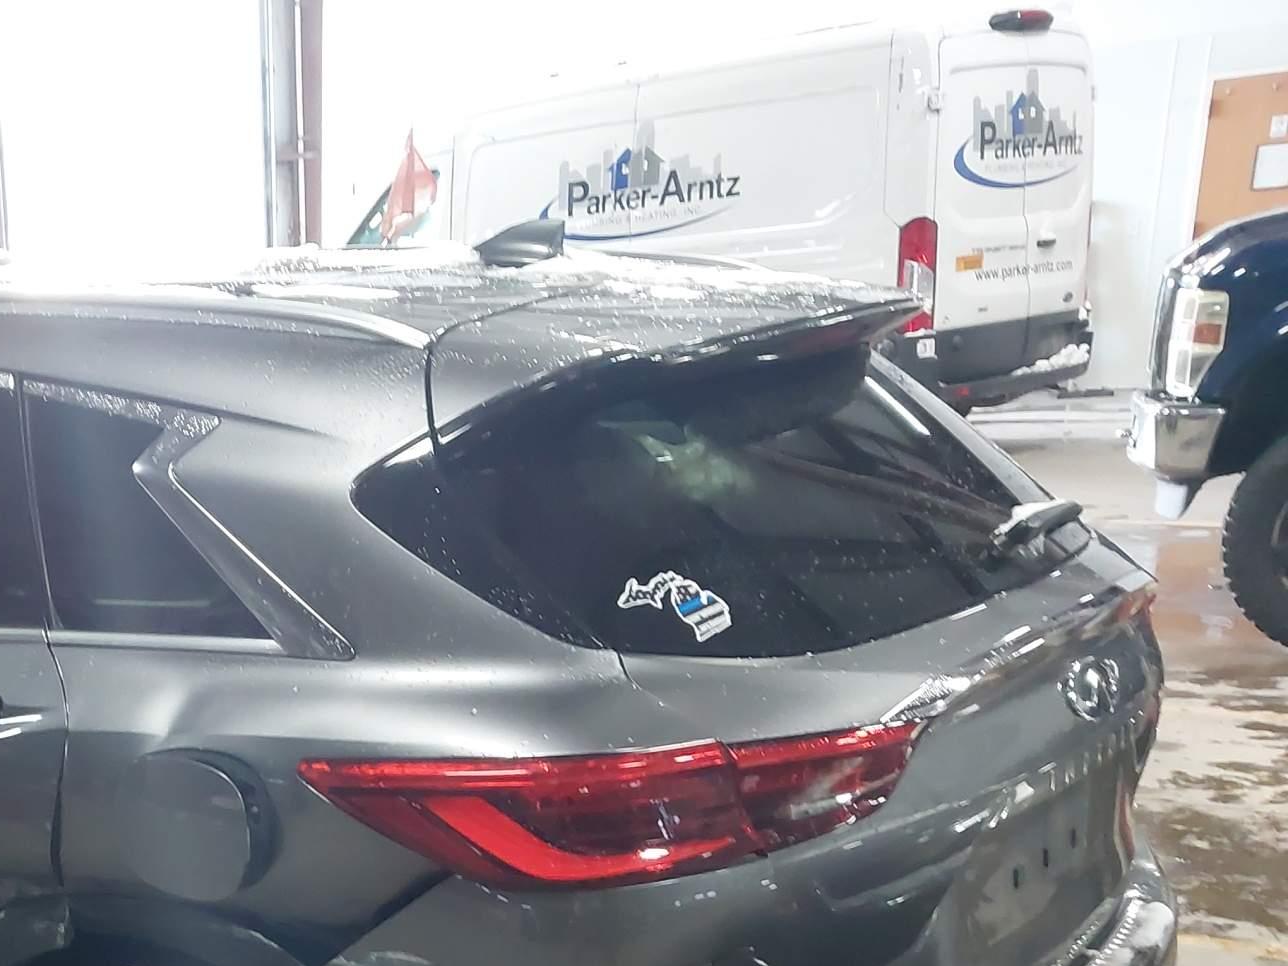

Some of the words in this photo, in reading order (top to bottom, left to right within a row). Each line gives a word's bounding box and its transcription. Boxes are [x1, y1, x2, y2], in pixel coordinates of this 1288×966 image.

[979, 119, 1083, 160] Parker-Arntz
[567, 169, 740, 217] Parker-Arntz
[974, 260, 1073, 281] www.parker-arntz.com
